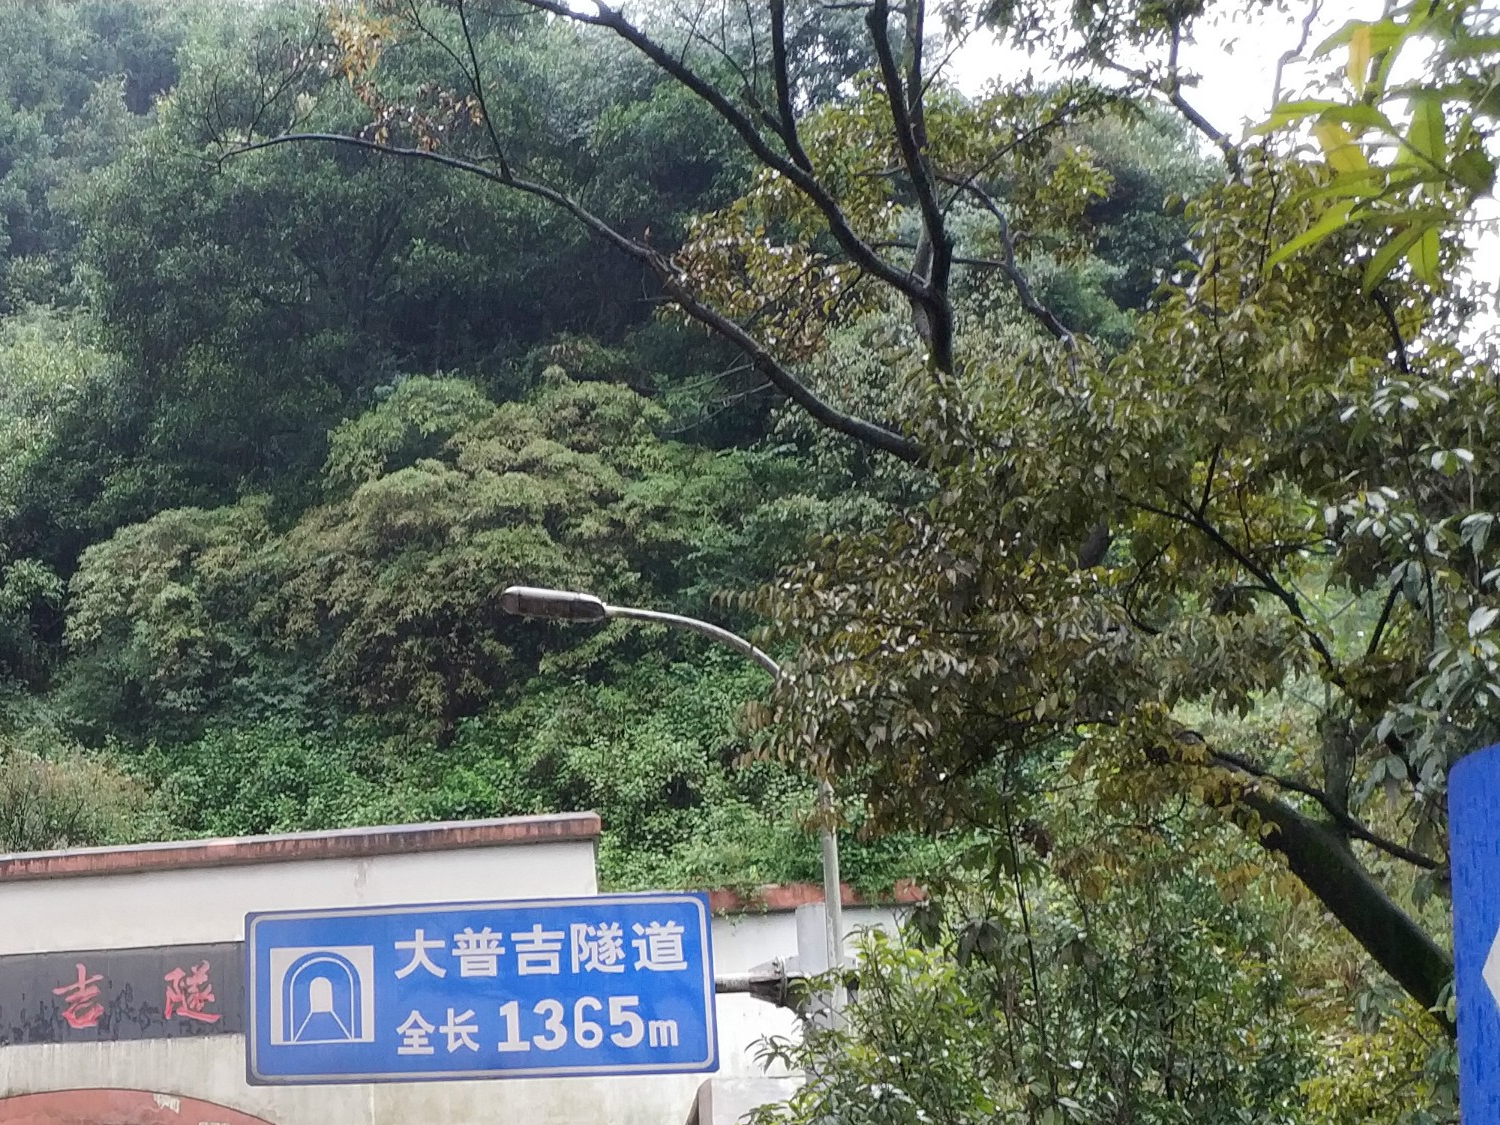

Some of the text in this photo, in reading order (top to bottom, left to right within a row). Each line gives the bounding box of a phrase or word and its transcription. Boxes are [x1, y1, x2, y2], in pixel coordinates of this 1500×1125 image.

[394, 920, 689, 980] 大普吉隧道
[395, 995, 680, 1056] 全长 1365m
